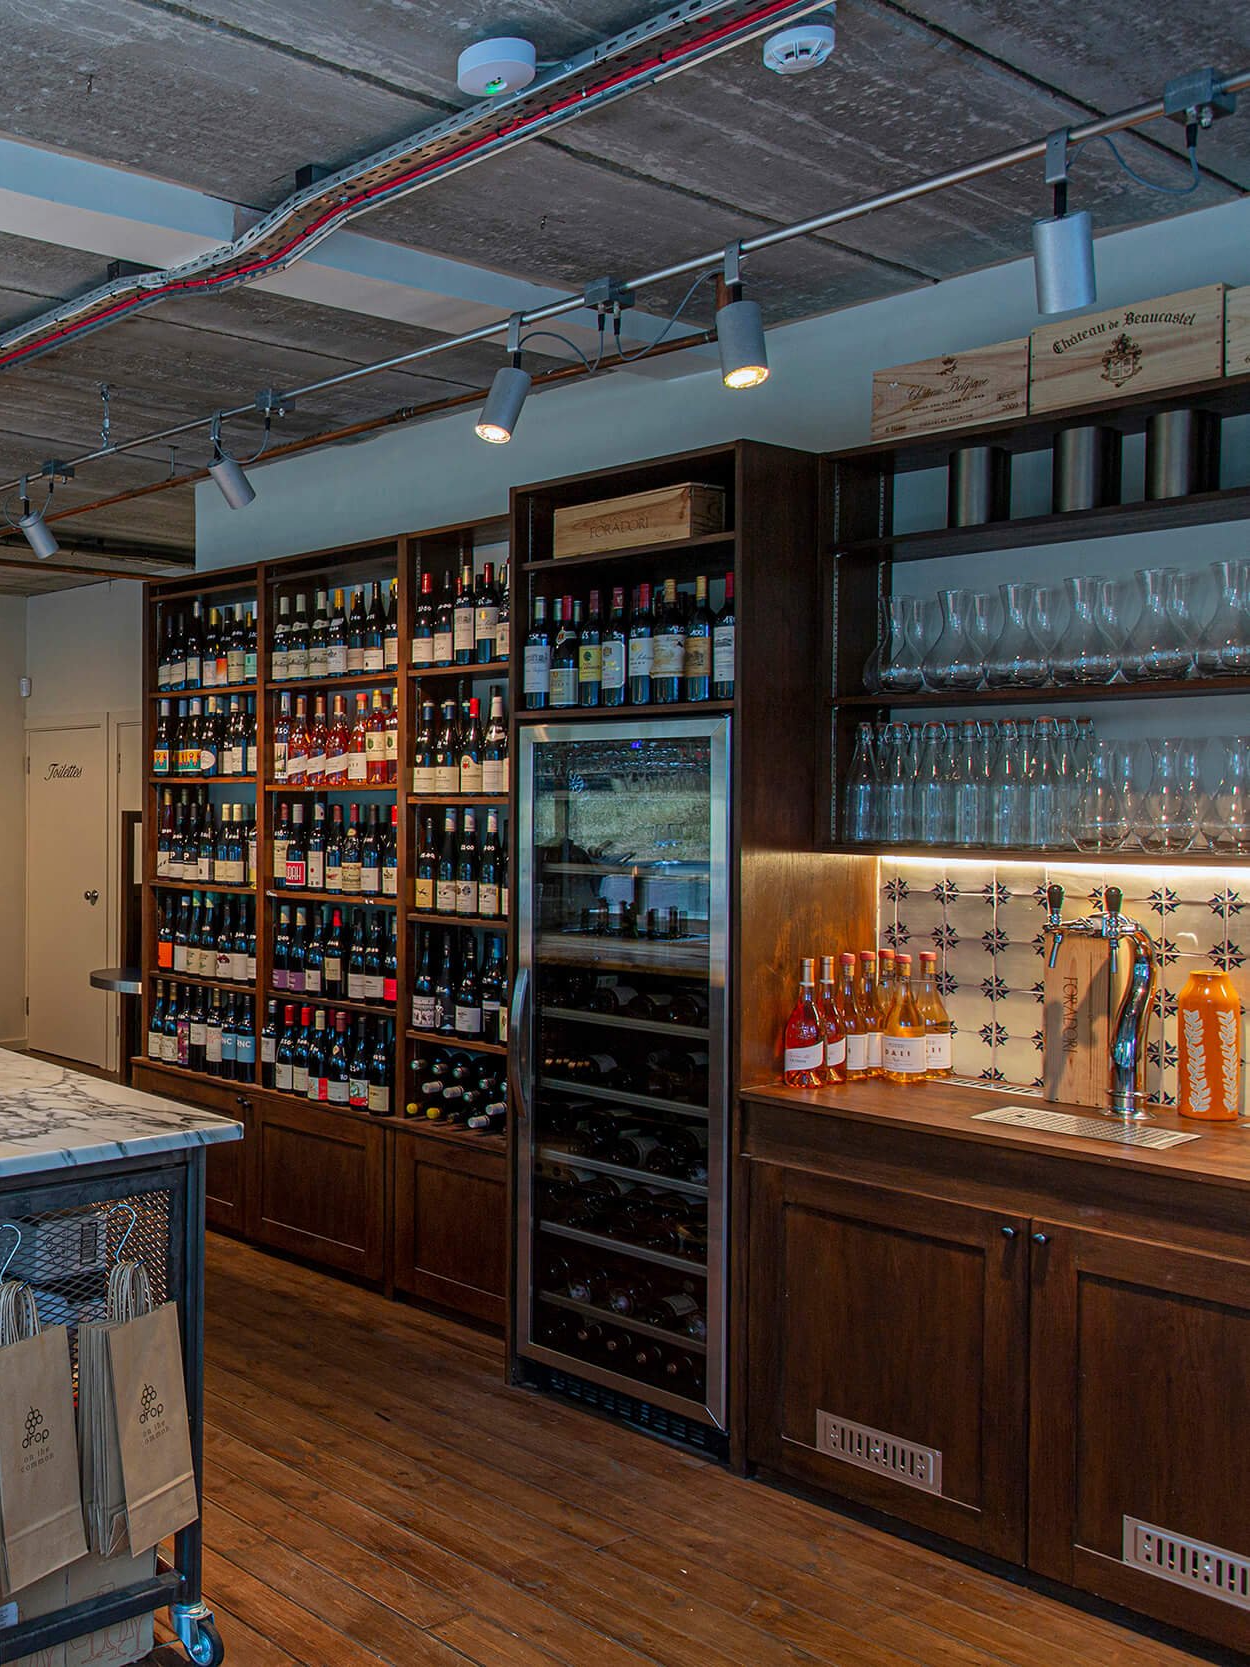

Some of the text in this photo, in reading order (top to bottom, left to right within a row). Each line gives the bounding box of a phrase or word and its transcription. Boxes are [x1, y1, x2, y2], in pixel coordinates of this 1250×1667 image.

[1052, 311, 1196, 354] Château de Beaucastel
[590, 517, 650, 539] FORADORI
[44, 763, 83, 781] Toilettes
[1062, 976, 1079, 1054] FORADORI
[139, 1403, 164, 1424] drop
[22, 1429, 50, 1449] drop
[24, 1454, 34, 1464] on
